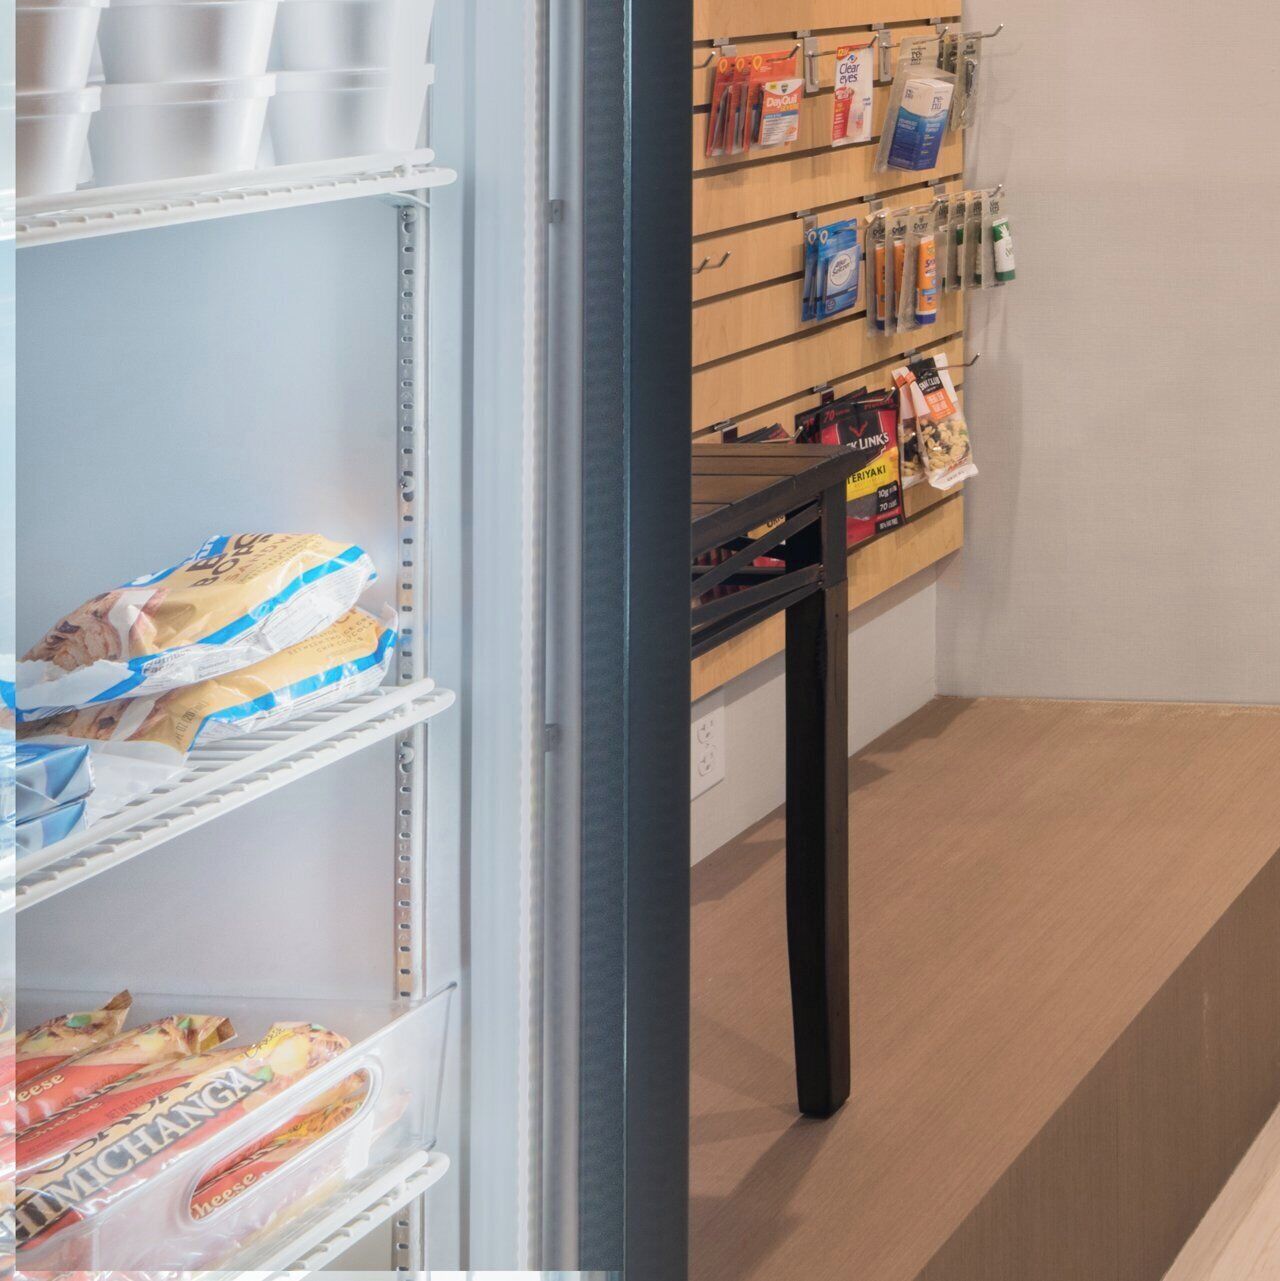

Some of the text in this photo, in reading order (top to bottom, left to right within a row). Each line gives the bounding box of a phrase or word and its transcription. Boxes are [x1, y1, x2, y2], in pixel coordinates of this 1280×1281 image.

[839, 62, 860, 75] Clear
[839, 74, 858, 85] eyes
[766, 95, 798, 110] DayQuil
[913, 222, 929, 233] SPORT
[859, 432, 890, 451] LINK'S
[847, 465, 886, 484] TERIYAKI
[878, 489, 890, 498] 10g
[15, 1064, 265, 1244] HIMICHANGA
